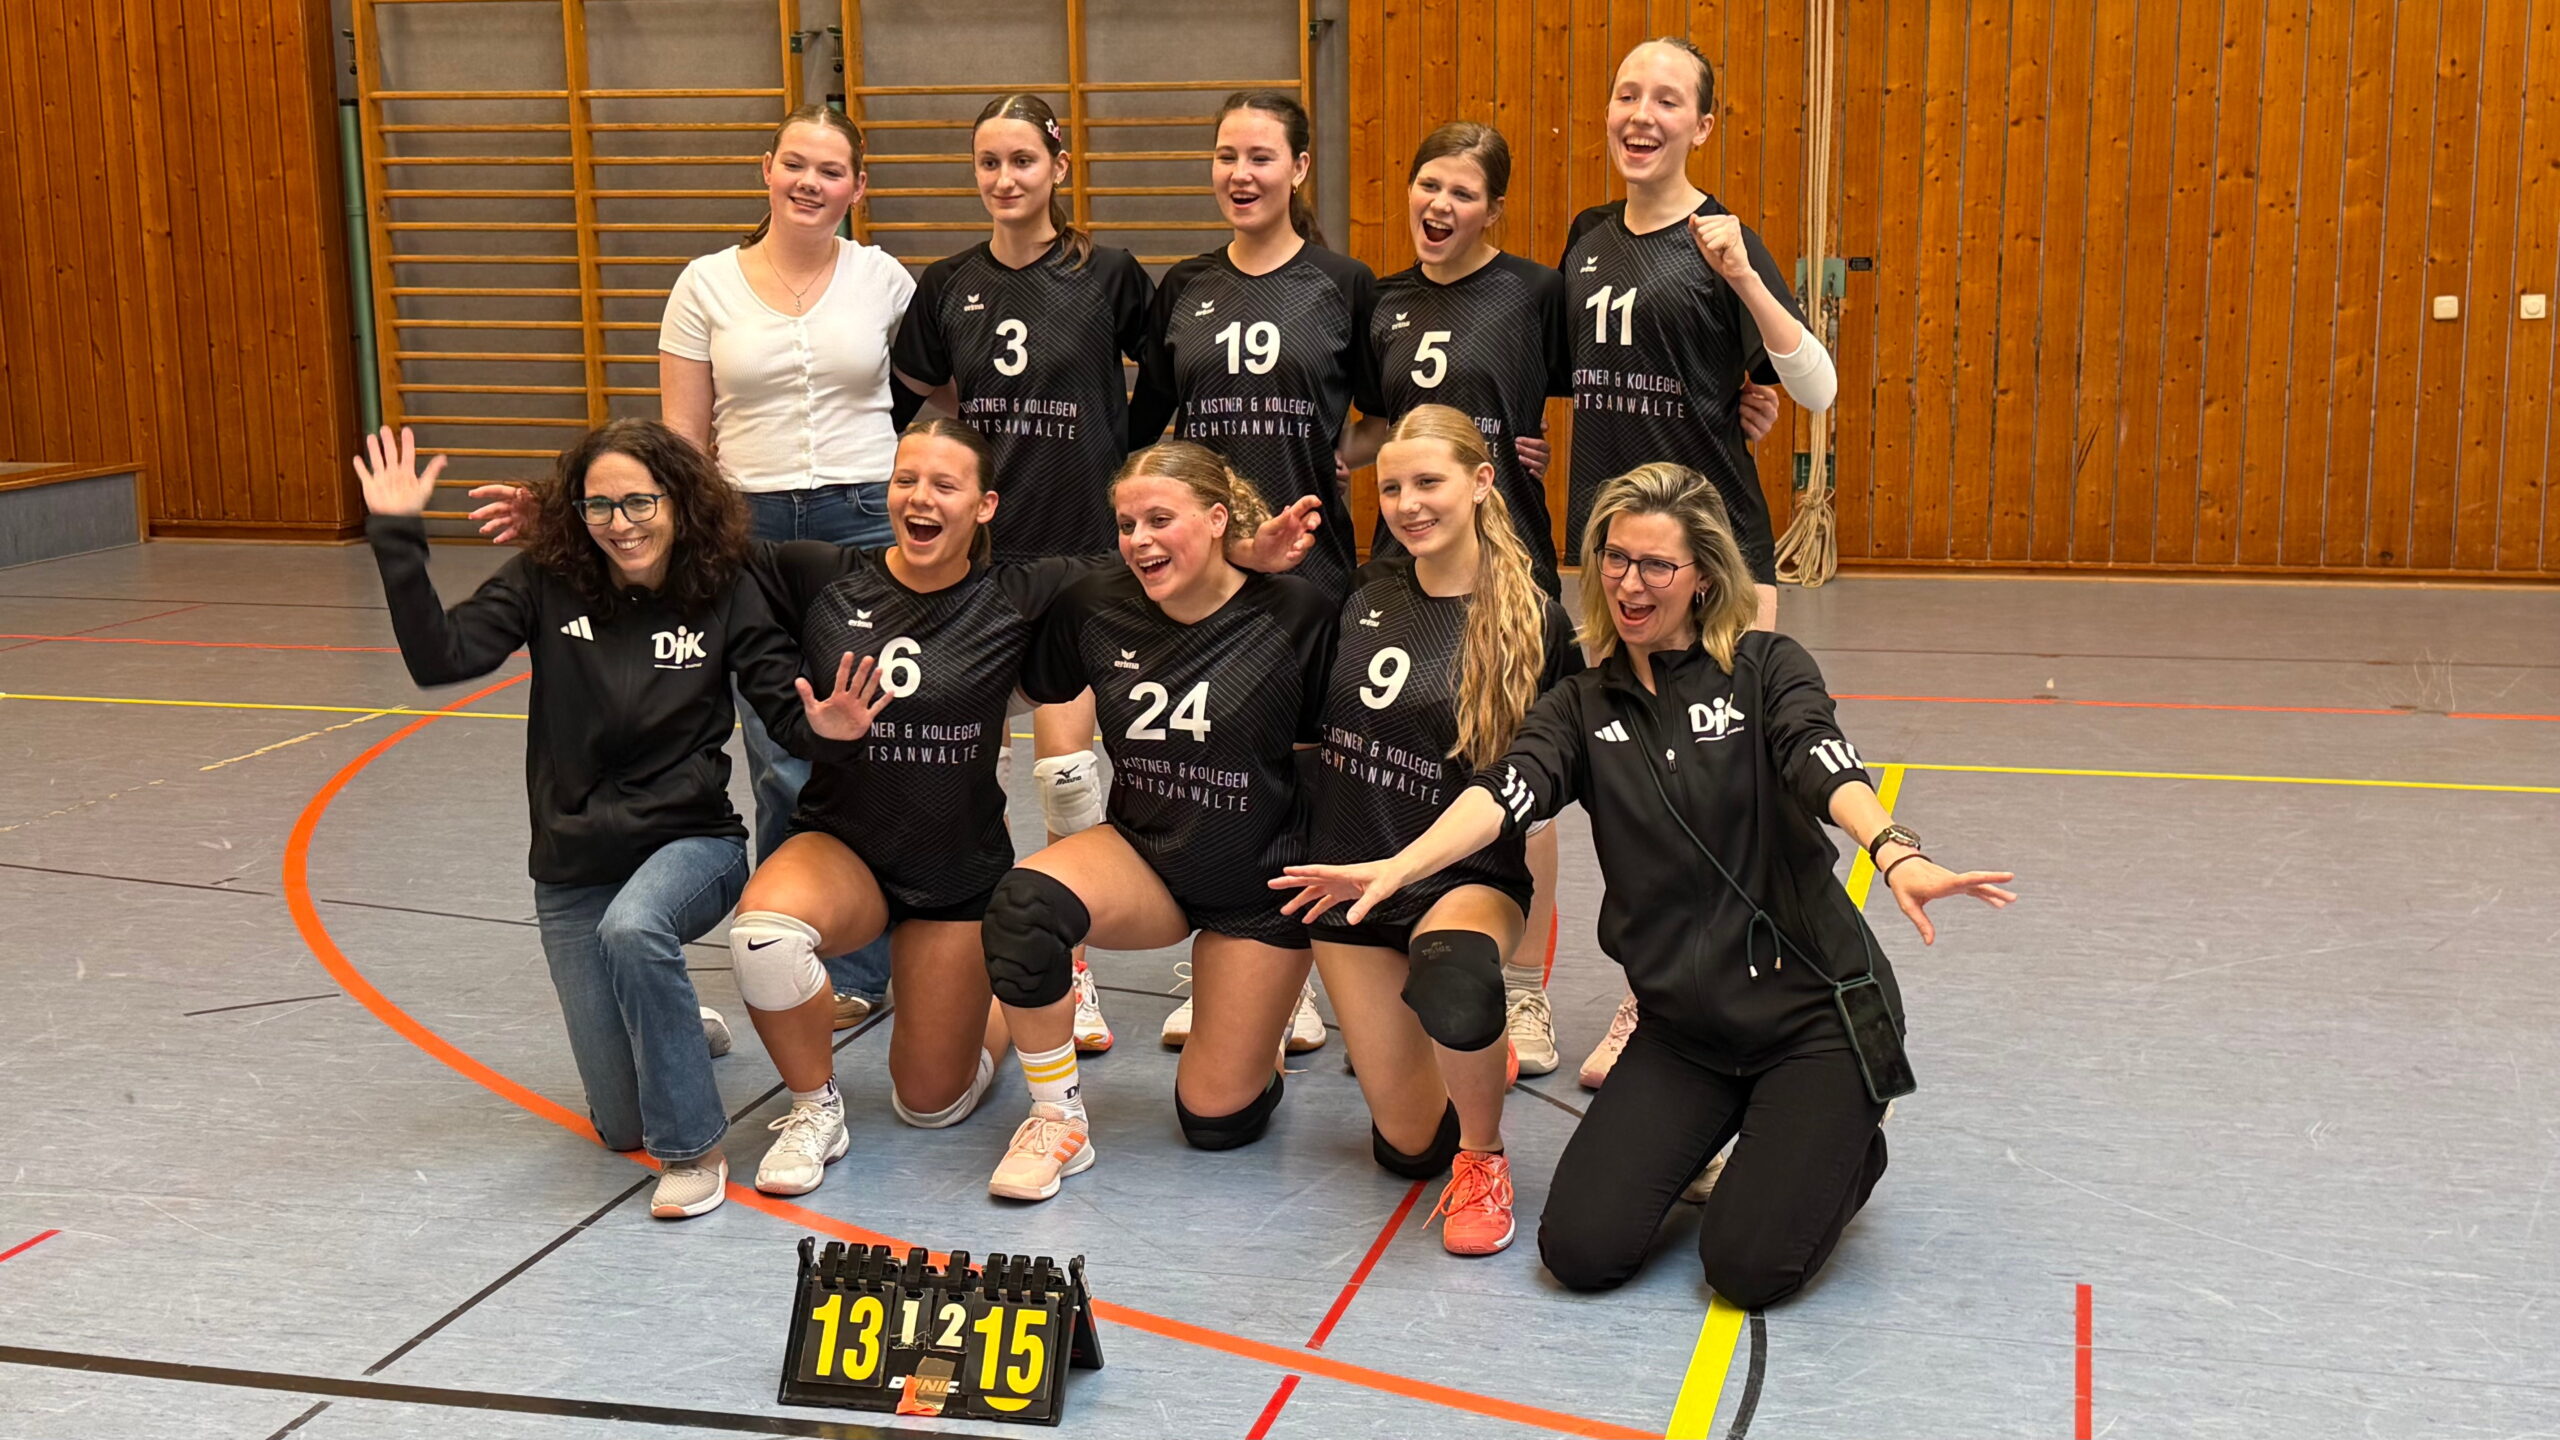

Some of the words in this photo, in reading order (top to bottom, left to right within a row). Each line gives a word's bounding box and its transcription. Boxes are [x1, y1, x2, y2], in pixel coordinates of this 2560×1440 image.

[1585, 285, 1638, 346] 11
[993, 318, 1029, 377] 3
[1215, 321, 1281, 375] 19
[1411, 331, 1452, 389] 5
[1614, 371, 1621, 387] &
[1627, 372, 1682, 397] KOLLEGEN
[1013, 397, 1020, 413] &
[1024, 399, 1078, 418] KOLLEGEN
[1201, 397, 1243, 414] KISTNER
[1250, 396, 1258, 412] &
[1265, 396, 1315, 417] KOLLEGEN
[1573, 393, 1685, 419] HTSANWÄLTE
[878, 636, 922, 698] 6
[1114, 660, 1140, 670] erima
[1359, 646, 1411, 710] 9
[1125, 681, 1212, 743] 24
[905, 723, 913, 739] &
[922, 721, 982, 742] KOLLEGEN
[869, 744, 979, 764] TSANWÄLTE
[1370, 740, 1380, 758] &
[1386, 745, 1443, 780] KOLLEGEN
[1122, 757, 1172, 774] KISTNER
[1178, 762, 1186, 778] &
[1190, 764, 1249, 789] KOLLEGEN
[812, 1294, 884, 1381] 13
[902, 1300, 920, 1345] 1
[936, 1303, 967, 1347] 2
[974, 1306, 1047, 1395] 15
[888, 1375, 958, 1394] DNIC
